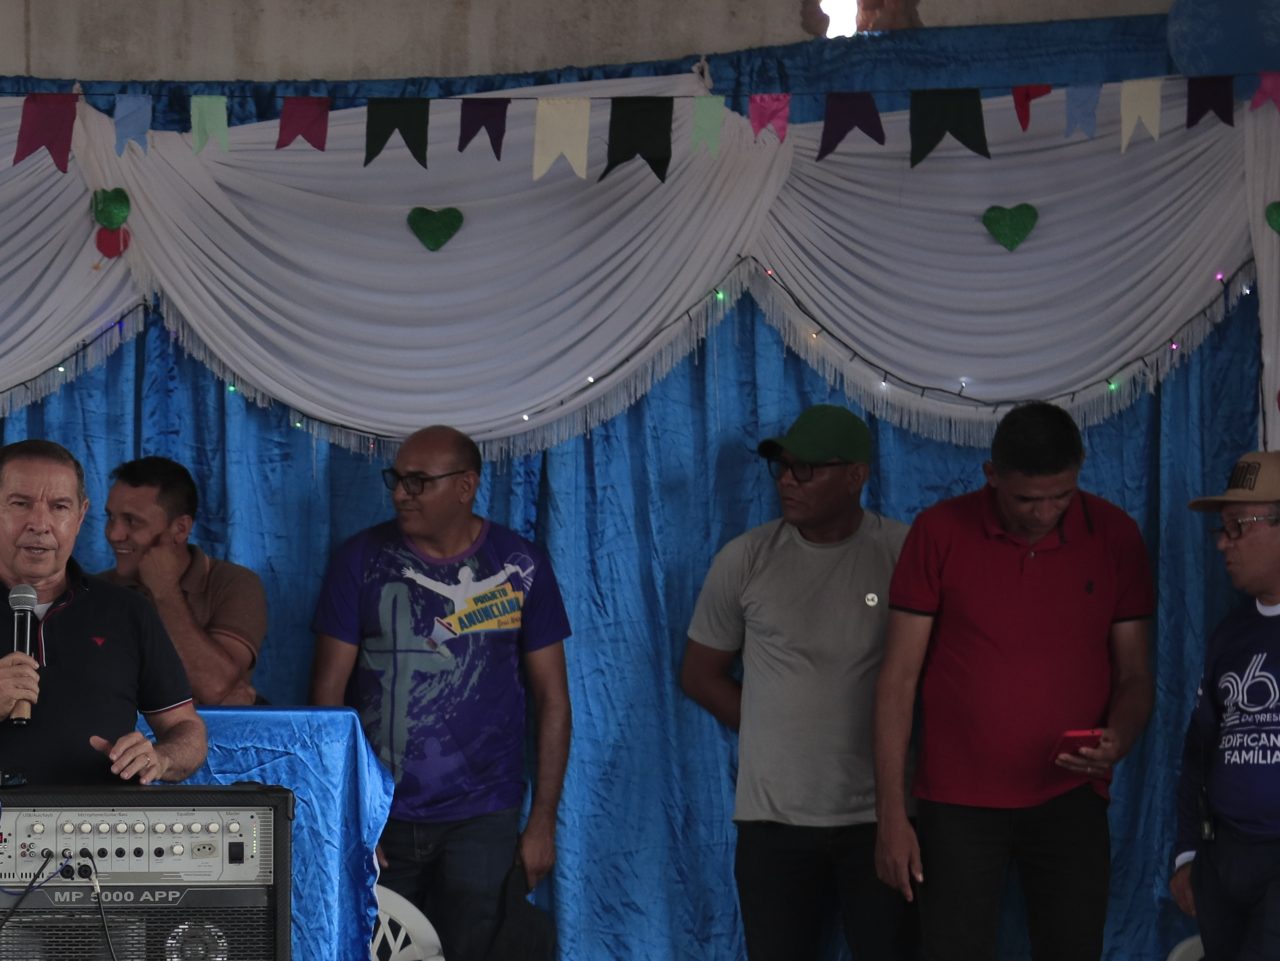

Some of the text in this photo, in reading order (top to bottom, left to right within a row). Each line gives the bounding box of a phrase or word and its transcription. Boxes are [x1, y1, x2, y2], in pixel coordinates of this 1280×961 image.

[1224, 746, 1280, 765] FAMÍLIA
[54, 890, 84, 902] MP
[139, 890, 181, 902] APP
